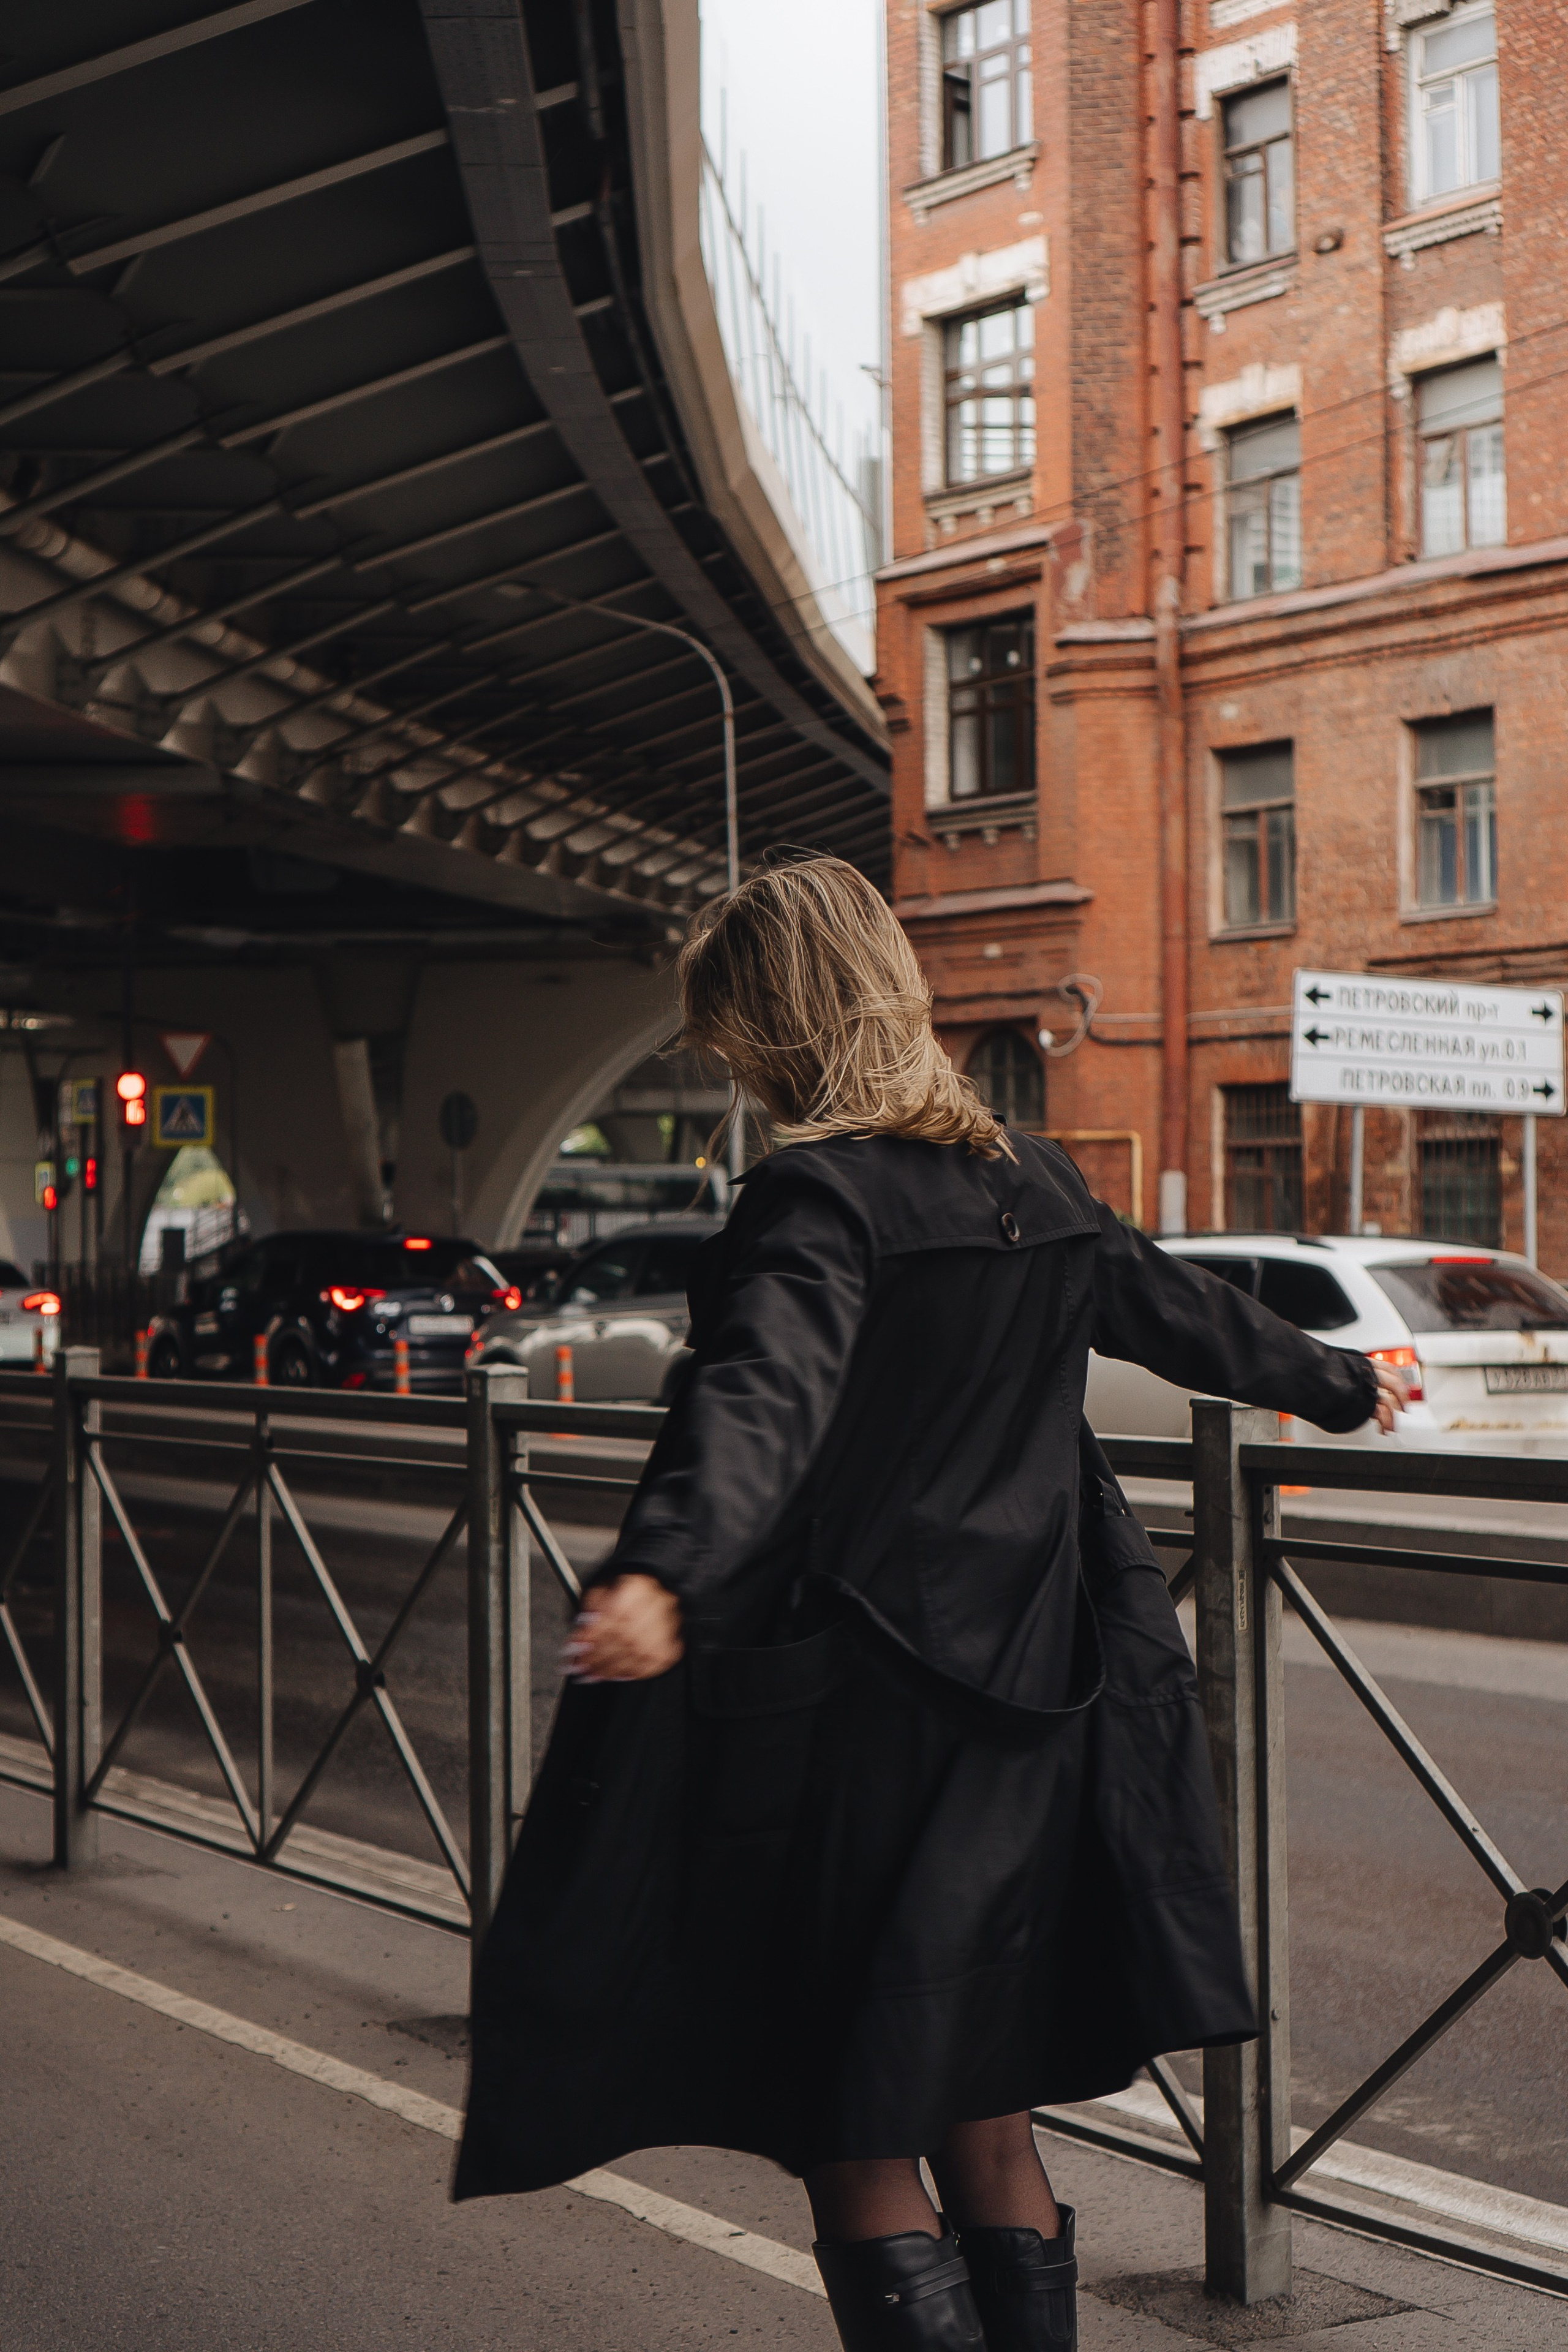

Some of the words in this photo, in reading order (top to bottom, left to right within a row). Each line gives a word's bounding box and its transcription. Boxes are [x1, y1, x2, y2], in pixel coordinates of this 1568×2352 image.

[1340, 986, 1460, 1017] ПЕТРОВСКИЙ
[1466, 1000, 1499, 1022] пр-т
[1335, 1026, 1476, 1057] РЕМЕСЛЕННАЯ
[1341, 1067, 1466, 1096] ПЕТРОВСКАЯ
